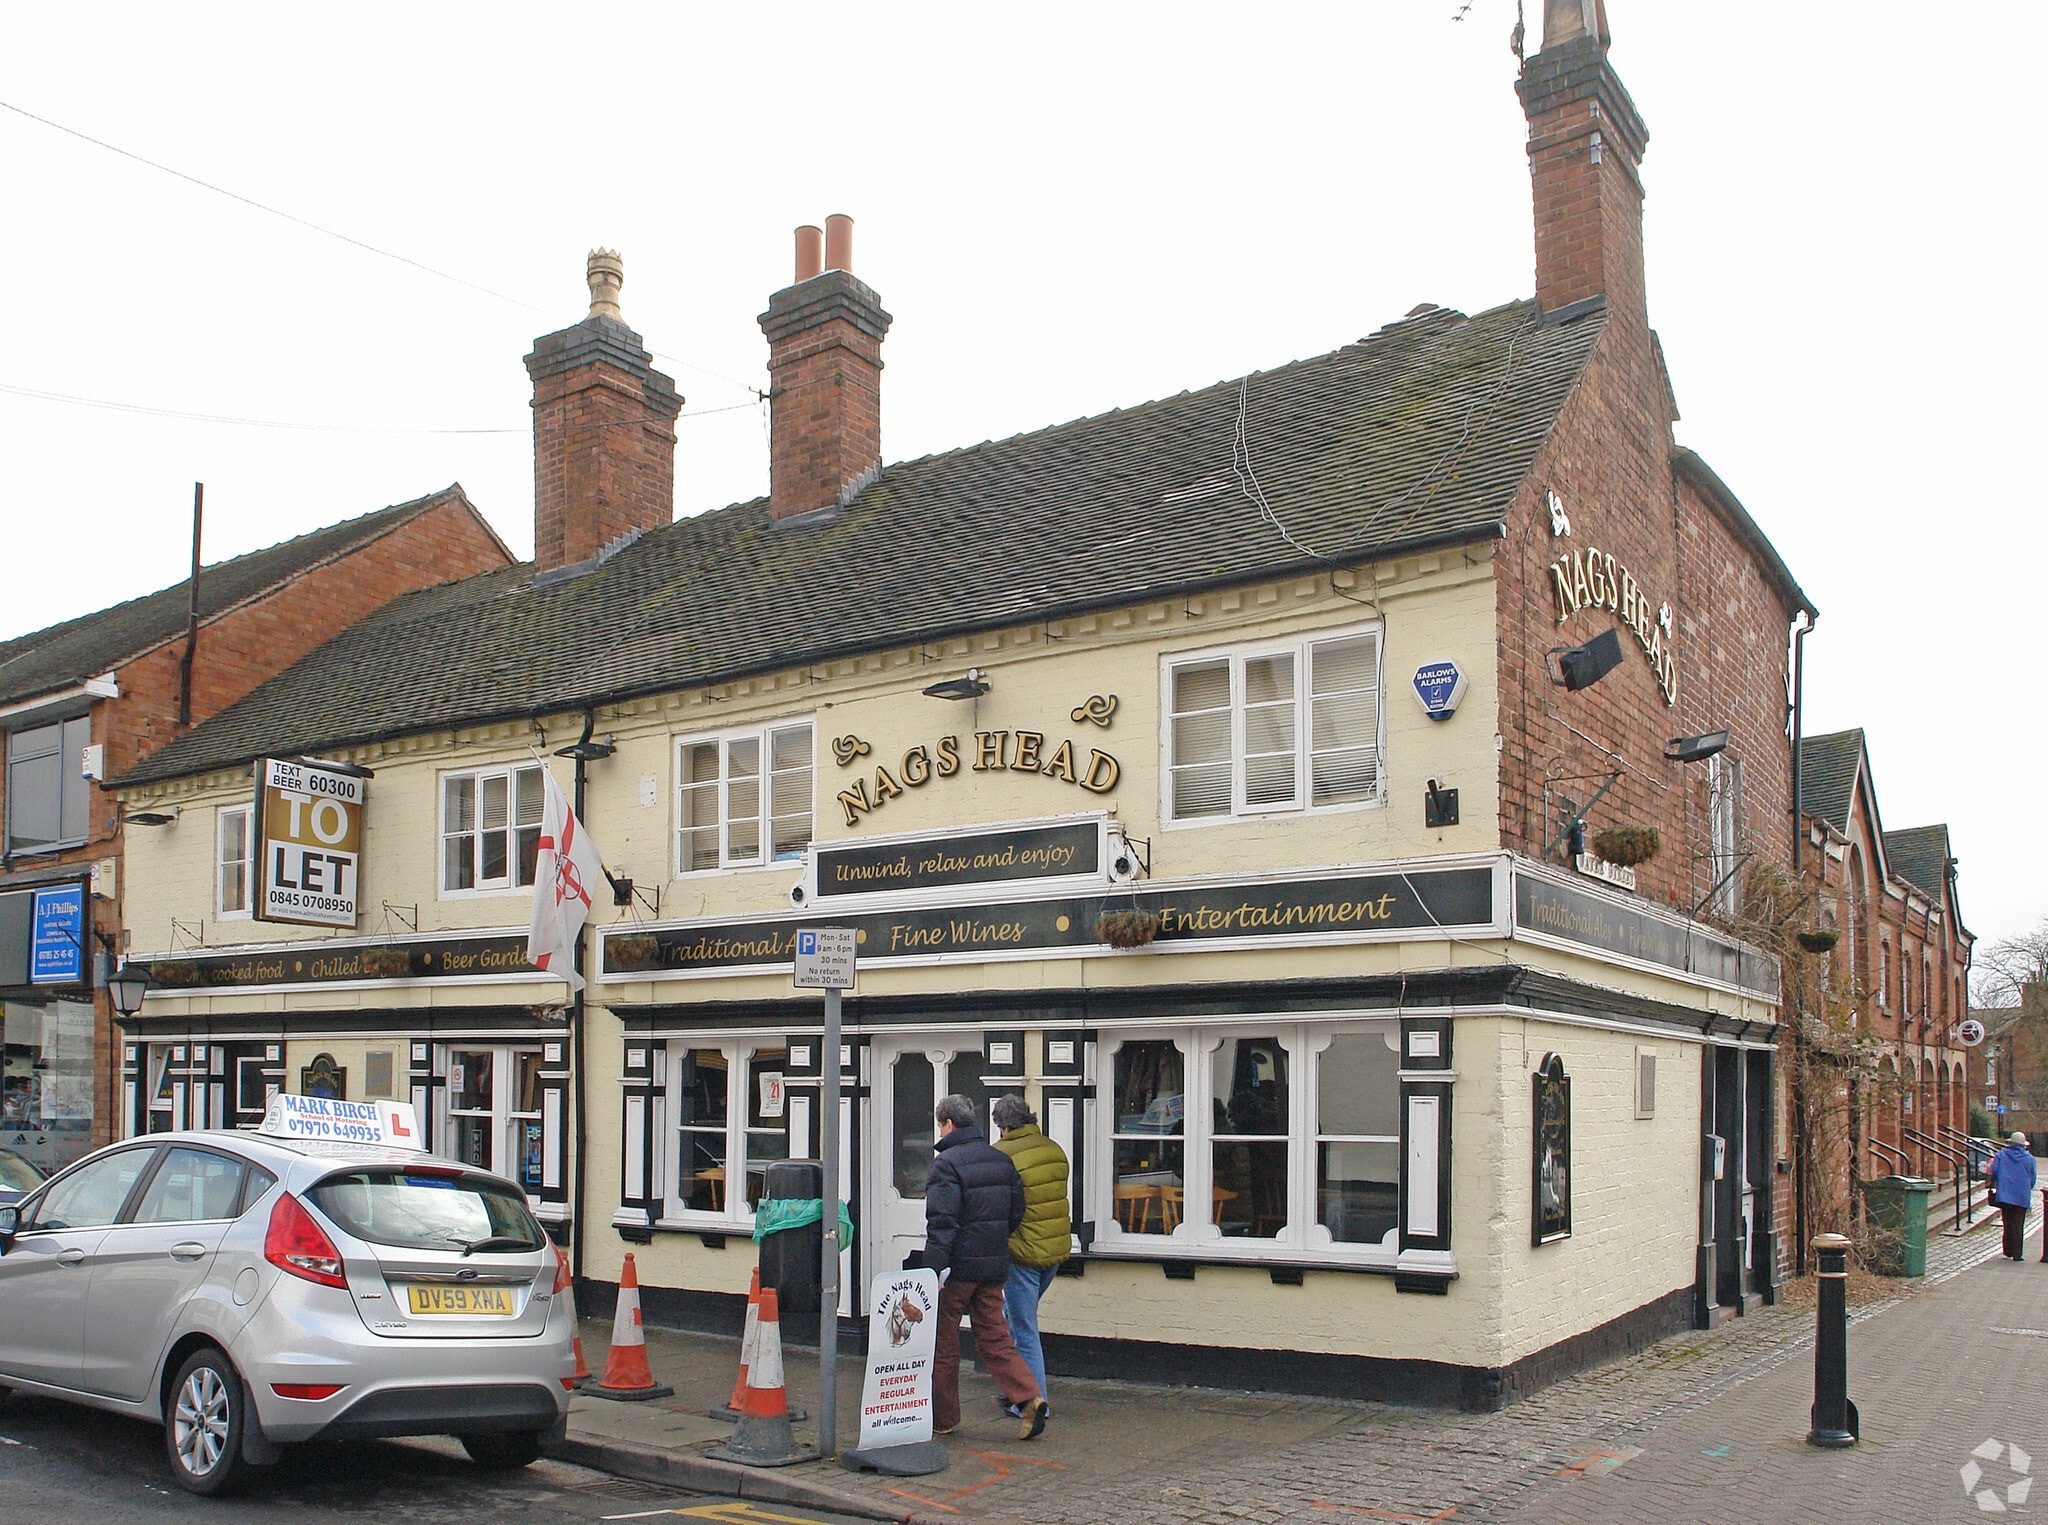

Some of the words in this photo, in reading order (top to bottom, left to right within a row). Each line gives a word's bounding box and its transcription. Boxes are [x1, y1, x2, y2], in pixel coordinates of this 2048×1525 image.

[1551, 547, 1618, 626] NAGS
[1620, 565, 1677, 708] HEAD
[1417, 668, 1455, 680] BARLOWS
[1421, 676, 1452, 687] ALARMS
[273, 776, 302, 790] BEER
[275, 763, 301, 777] TEXT
[309, 775, 355, 798] 60300
[837, 735, 960, 826] NAGS
[972, 731, 1120, 794] HEAD
[280, 789, 349, 844] TO
[275, 847, 352, 895] LET
[836, 857, 912, 882] Unwind,
[918, 853, 973, 875] relax
[973, 846, 1020, 868] and
[1021, 844, 1075, 870] enjoy
[270, 891, 300, 906] 0845
[303, 895, 353, 913] 0708950
[1160, 893, 1397, 932] Entertainment
[1530, 894, 1593, 936] Traditional
[1593, 913, 1614, 943] Ales
[891, 925, 947, 951] Fine
[950, 920, 1027, 944] Wines
[442, 951, 477, 970] Beer
[480, 945, 529, 967] Garde
[661, 932, 784, 962] Traditional
[212, 963, 254, 980] cooked
[255, 960, 285, 982] food
[311, 956, 362, 978] Chilled
[809, 967, 818, 975] No
[820, 956, 831, 964] 30
[832, 956, 848, 964] mins
[800, 975, 820, 984] within
[821, 976, 831, 984] 30
[832, 976, 848, 984] mins
[771, 1081, 780, 1098] 21
[285, 1096, 331, 1116] MARK
[332, 1101, 378, 1121] BIRCH
[288, 1119, 330, 1136] 07970
[333, 1122, 382, 1142] 649935
[300, 1113, 325, 1121] School
[335, 1117, 368, 1127] Motoring
[391, 1113, 411, 1137] L
[417, 1288, 467, 1310] DV59
[470, 1290, 506, 1311] XNA
[877, 1293, 892, 1315] The
[891, 1278, 914, 1293] Nags
[914, 1282, 932, 1311] Head
[874, 1363, 896, 1375] OPEN
[896, 1362, 910, 1371] ALL
[911, 1360, 926, 1369] DAY
[880, 1373, 918, 1387] EVERYDAY
[880, 1387, 915, 1400] REGULAR
[864, 1398, 929, 1415] ENTERTAINMENT
[871, 1420, 881, 1428] all
